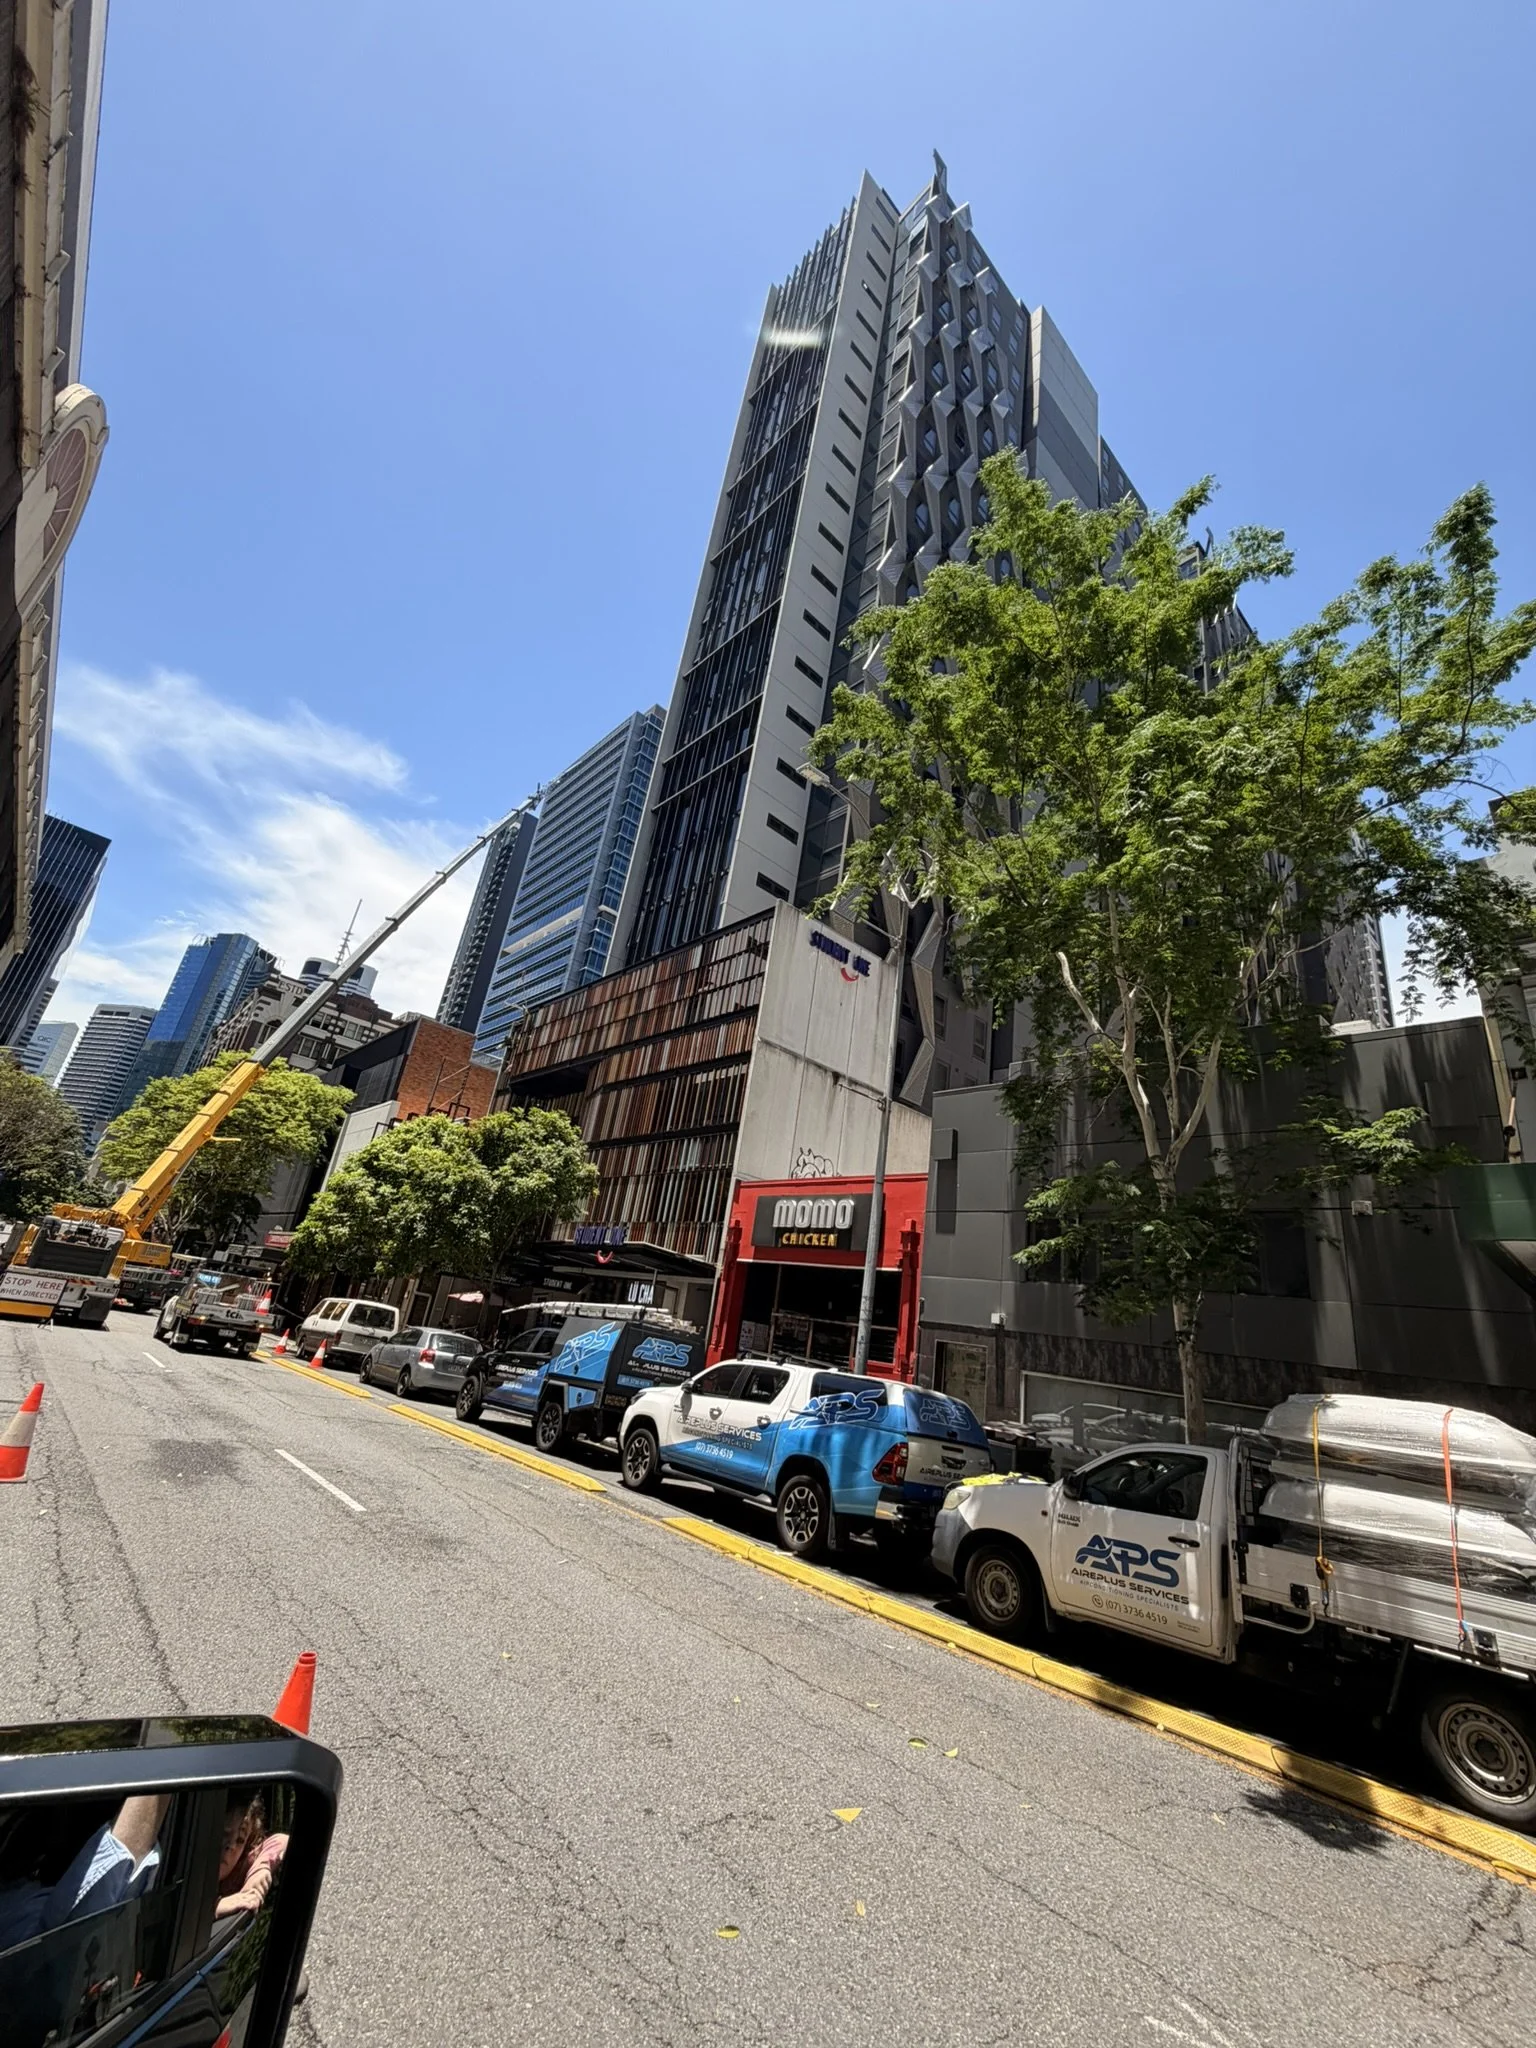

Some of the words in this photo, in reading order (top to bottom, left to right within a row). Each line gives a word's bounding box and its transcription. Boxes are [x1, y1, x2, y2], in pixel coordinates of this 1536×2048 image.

[278, 980, 304, 995] ESTD
[574, 1225, 606, 1245] STUDENT
[782, 1232, 838, 1247] CHICKEN
[0, 1288, 22, 1296] WHEN
[23, 1289, 59, 1300] DIRECTED
[4, 1276, 32, 1286] STOP
[36, 1280, 64, 1291] HERE
[638, 1283, 655, 1304] CHA
[554, 1321, 616, 1372] APS
[632, 1336, 693, 1367] APS
[660, 1365, 691, 1377] SERVICES
[788, 1388, 885, 1430] APS
[919, 1397, 972, 1430] APS
[718, 1422, 762, 1442] SERVICES
[1075, 1534, 1181, 1588] APS
[1071, 1567, 1126, 1588] AIREPLUS
[1129, 1582, 1189, 1605] SERVICES
[1105, 1599, 1122, 1613] (07)
[1122, 1604, 1145, 1618] 3736
[1145, 1609, 1168, 1625] 4519
